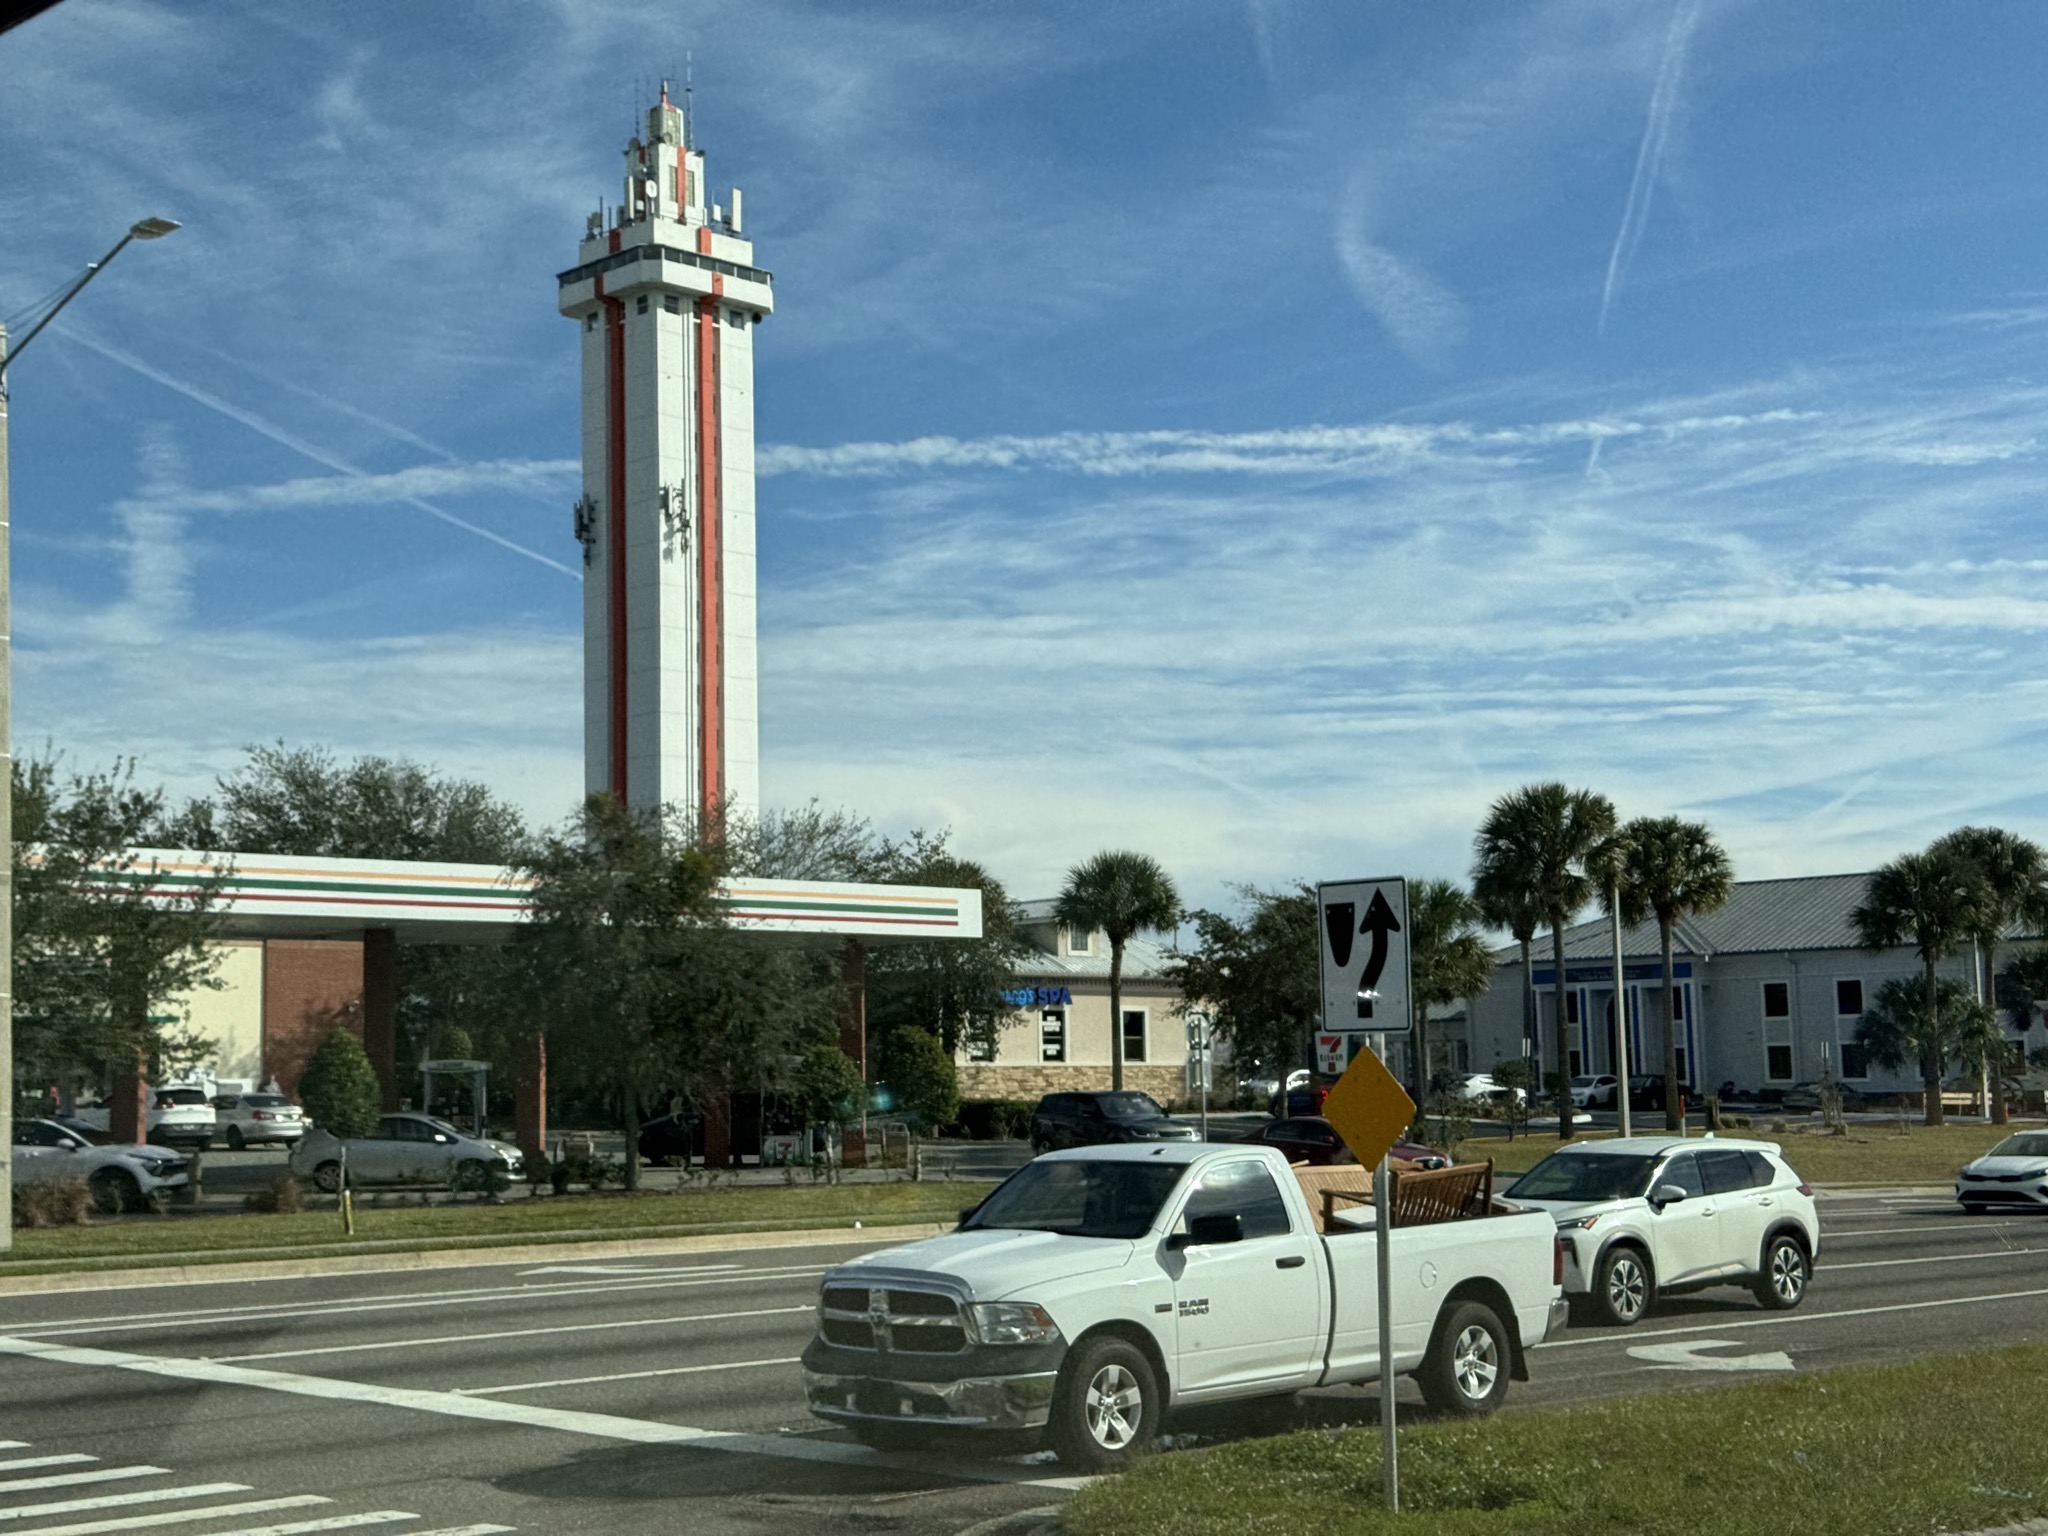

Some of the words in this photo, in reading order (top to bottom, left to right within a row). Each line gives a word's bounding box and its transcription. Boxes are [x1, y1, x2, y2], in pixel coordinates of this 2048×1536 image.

[1038, 986, 1073, 1006] SPA
[1178, 1298, 1209, 1308] RAM
[1179, 1306, 1210, 1317] 1500
